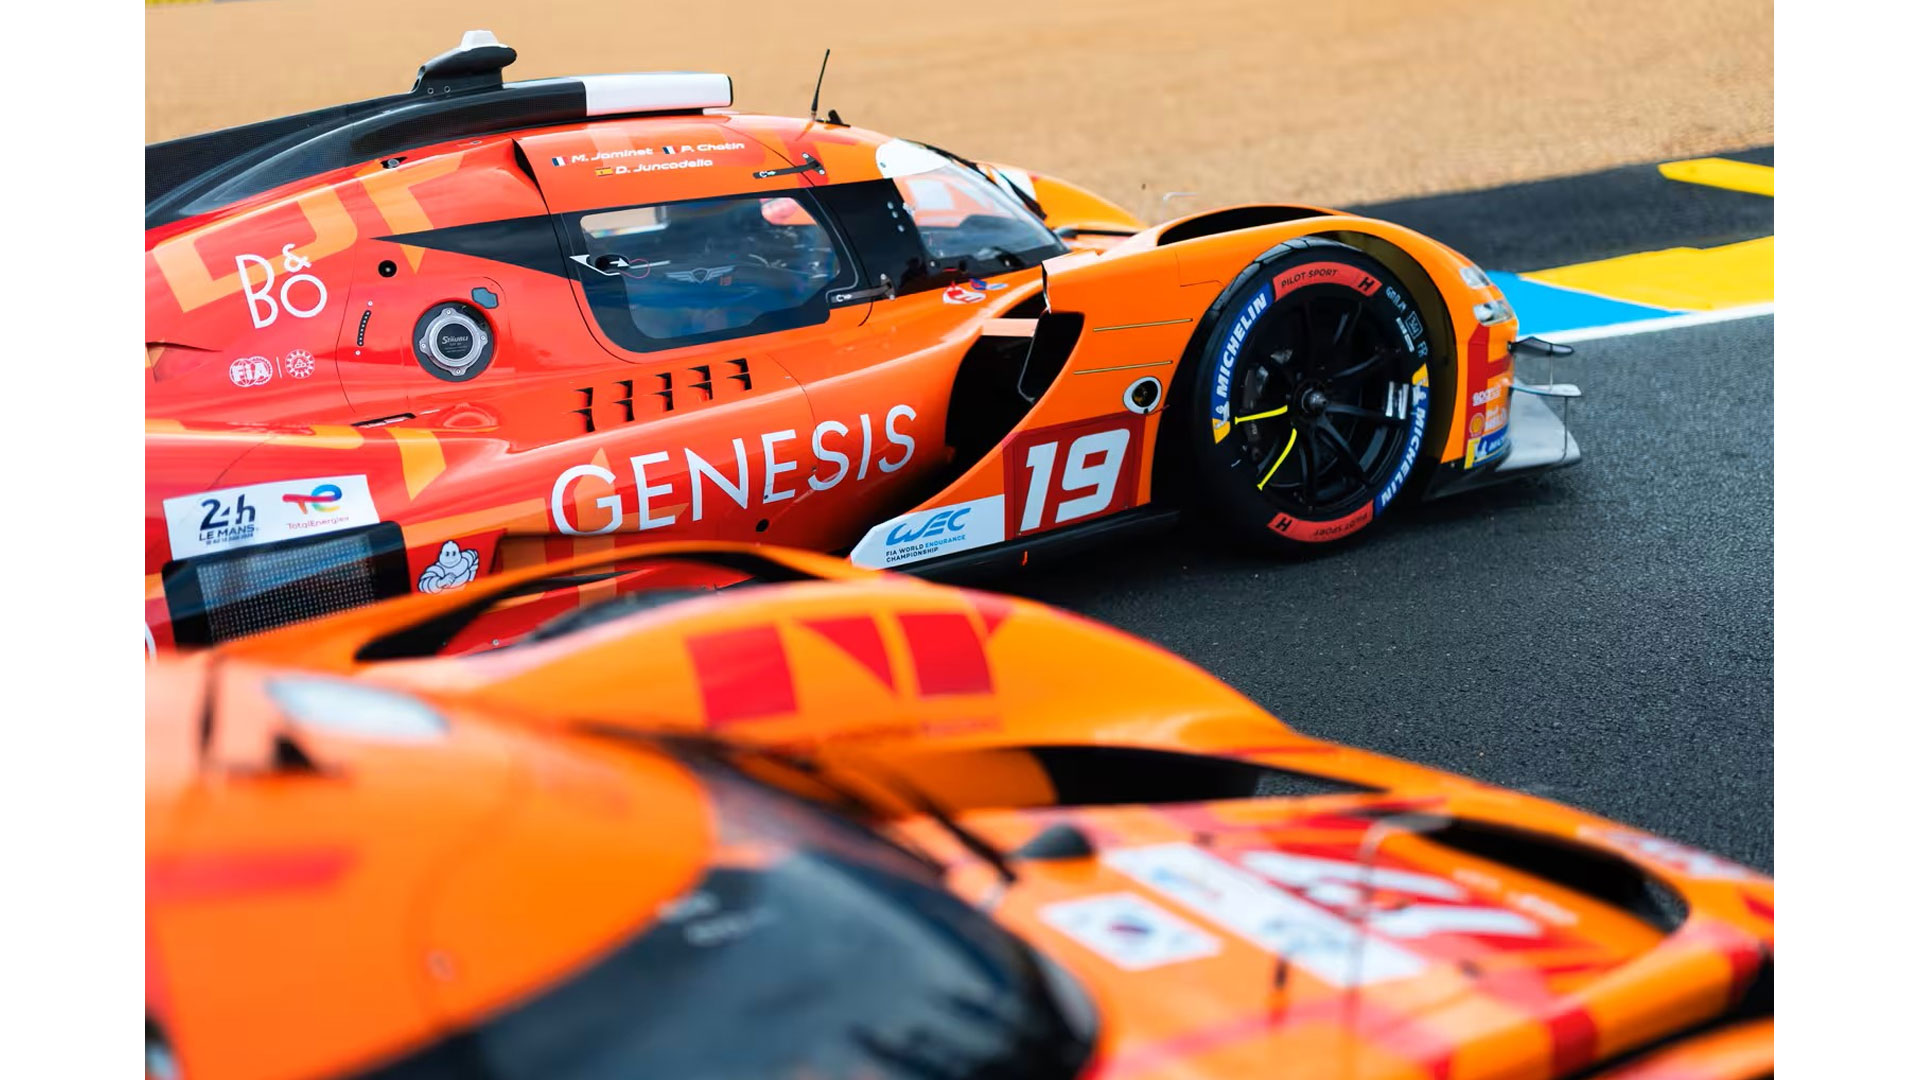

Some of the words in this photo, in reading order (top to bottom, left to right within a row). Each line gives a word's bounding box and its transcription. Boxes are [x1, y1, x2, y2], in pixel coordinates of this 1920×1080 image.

[571, 154, 588, 163] M.
[591, 147, 653, 161] Jaminet
[681, 145, 695, 153] P.
[697, 143, 745, 152] Chatin
[615, 165, 631, 174] D.
[633, 158, 713, 173] Juncadella
[1281, 272, 1306, 288] PILOT
[1308, 268, 1338, 278] SPORT
[1358, 276, 1375, 292] H
[1216, 293, 1267, 398] MICHELIN
[1381, 407, 1426, 506] MICHELIN
[551, 404, 917, 535] GENESIS
[1020, 428, 1130, 532] 19
[199, 531, 214, 541] LE
[217, 524, 255, 538] MANS
[886, 507, 972, 546] WEC
[1275, 517, 1292, 532] H
[899, 543, 924, 553] WORLD
[925, 534, 966, 548] ENDURANCE
[886, 547, 939, 562] CHAMPIONSHIP
